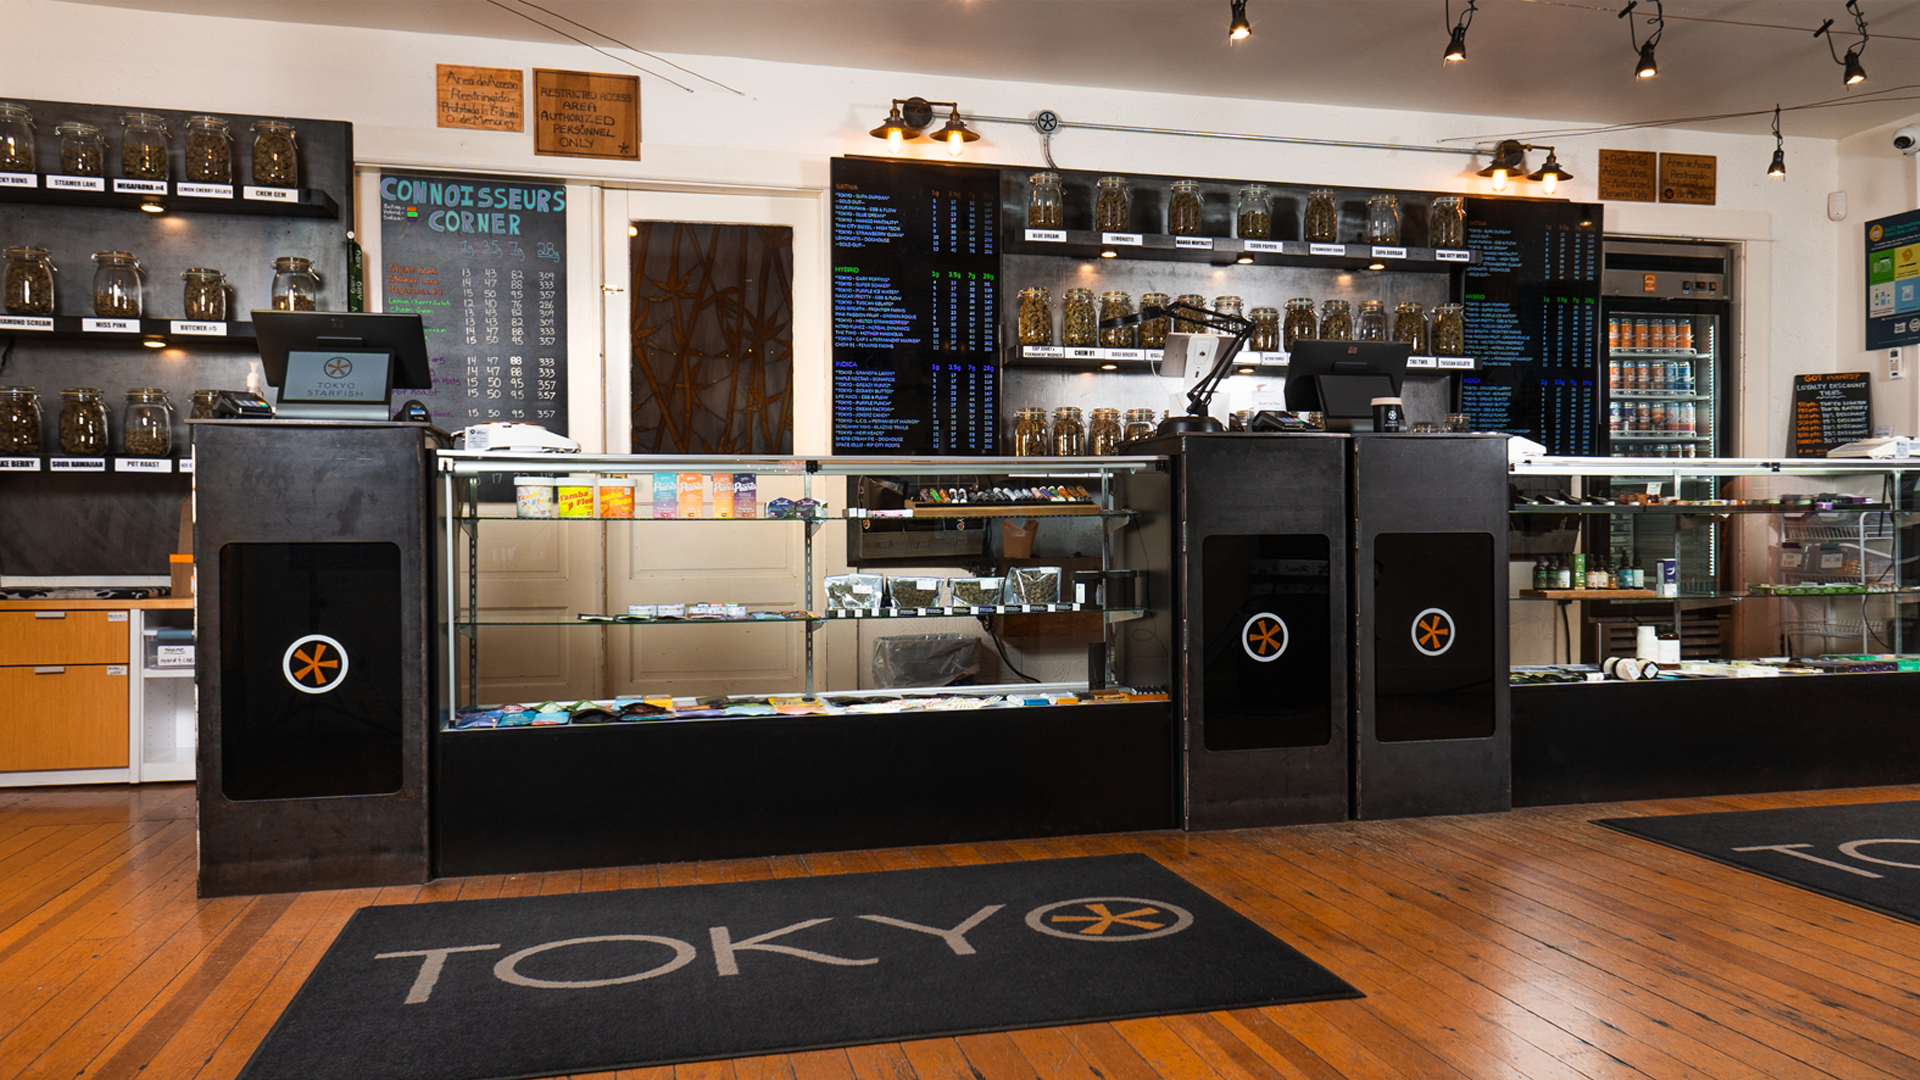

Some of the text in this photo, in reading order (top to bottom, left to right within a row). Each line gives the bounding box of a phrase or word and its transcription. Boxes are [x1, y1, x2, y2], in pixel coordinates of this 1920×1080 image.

[446, 71, 475, 86] Area
[540, 87, 633, 103] RESTRICTED ACCESS
[562, 101, 598, 113] AREA
[540, 110, 616, 126] AUTHORIZED
[553, 124, 616, 138] PERSONNEL
[559, 136, 595, 149] ONLY
[54, 179, 81, 187] STEAMER
[117, 182, 154, 191] MEGAFAUNA
[429, 210, 520, 235] CORNER
[461, 240, 474, 258] 1g
[508, 240, 525, 261] 7g
[537, 242, 561, 262] 28g
[462, 268, 471, 277] 13
[485, 268, 497, 278] 43
[511, 270, 524, 280] 82
[538, 271, 554, 281] 309
[462, 278, 472, 287] 14
[484, 279, 497, 288] 47
[511, 280, 523, 289] 88
[539, 281, 554, 290] 333
[463, 289, 474, 297] 15
[484, 289, 496, 298] 50
[511, 290, 523, 299] 95
[539, 291, 556, 300] 357
[463, 299, 475, 308] 12
[484, 299, 497, 308] 40
[511, 300, 523, 309] 76
[539, 301, 554, 309] 286
[464, 309, 475, 318] 13
[485, 309, 498, 318] 43
[511, 309, 524, 317] 82
[539, 309, 554, 319] 309
[26, 318, 51, 327] SCREAM
[96, 321, 112, 329] MISS
[464, 318, 554, 327] 13 43 82 309
[465, 327, 556, 336] 14 47 88 333
[466, 336, 556, 346] 15 50 95 357
[467, 357, 477, 366] 14
[487, 357, 499, 366] 47
[510, 356, 523, 366] 88
[538, 358, 555, 368] 333
[467, 366, 556, 379] 14 47 88 333
[1804, 374, 1821, 382] GOT
[467, 377, 557, 391] 15 50 95 357
[1796, 381, 1867, 391] LOYALTY DISCOUNT
[306, 389, 364, 397] STARFISH
[467, 388, 480, 399] 15
[486, 389, 502, 400] 50
[510, 389, 525, 400] 95
[537, 391, 557, 401] 357
[468, 408, 557, 419] 15 50 95 357
[11, 460, 35, 468] BERRY
[560, 491, 590, 502] Yamba
